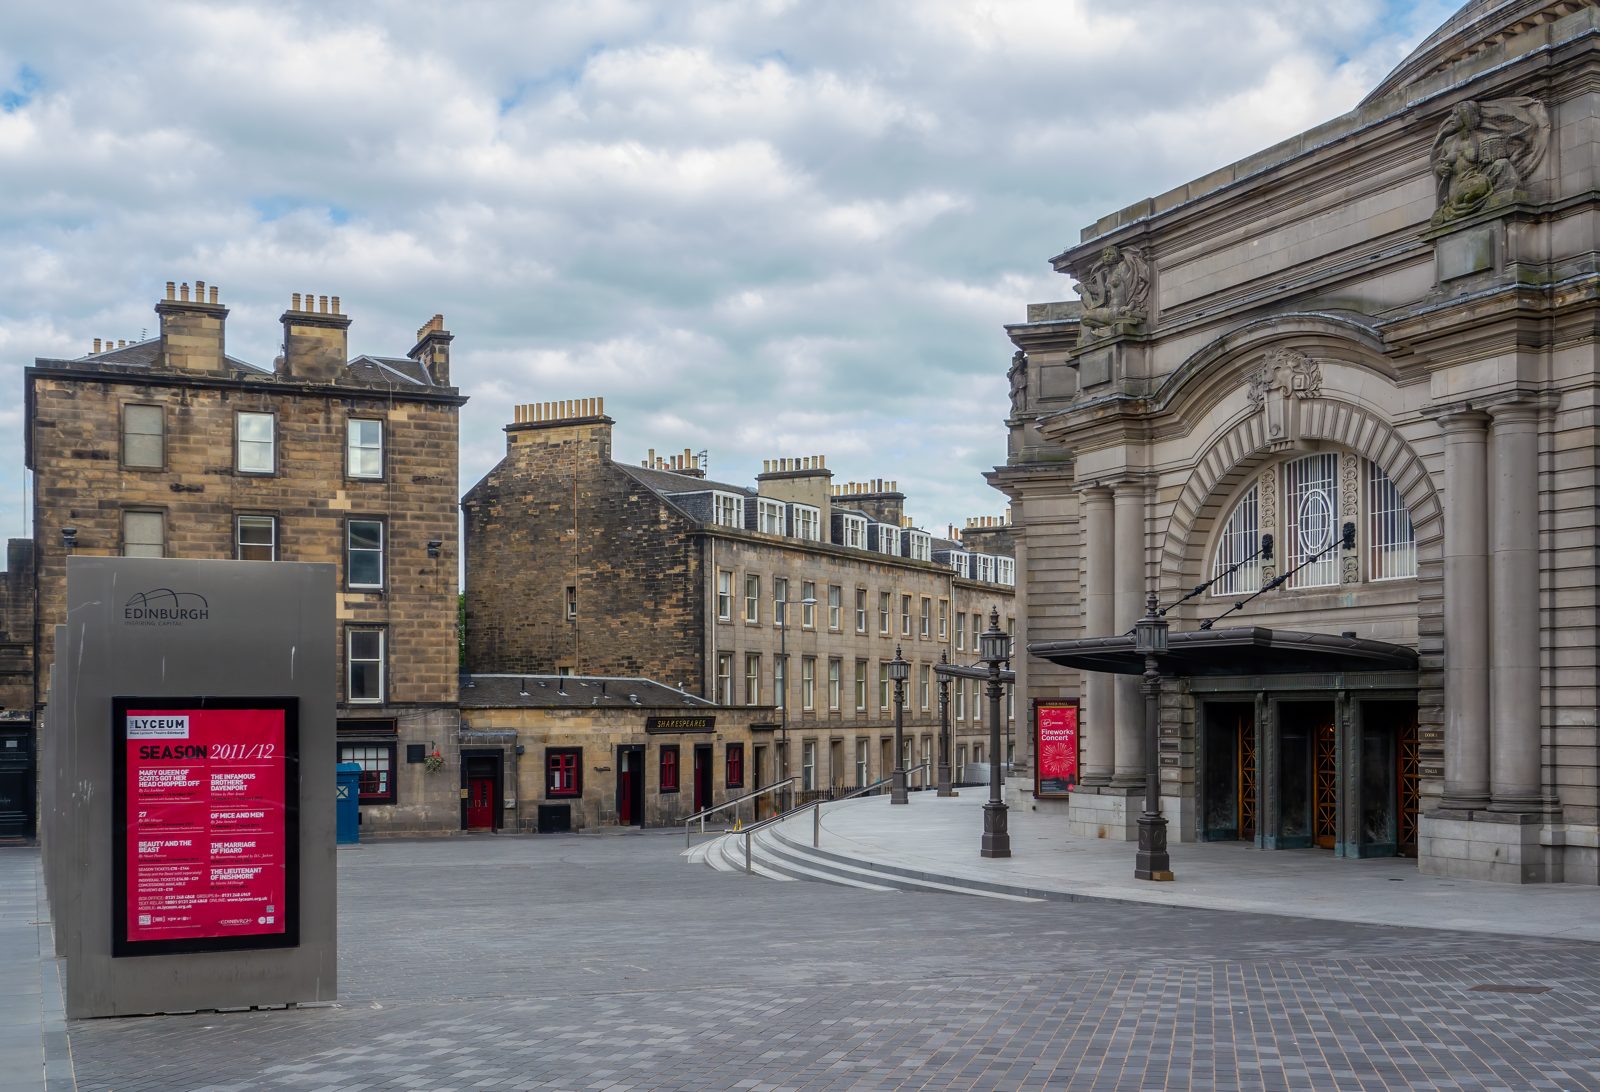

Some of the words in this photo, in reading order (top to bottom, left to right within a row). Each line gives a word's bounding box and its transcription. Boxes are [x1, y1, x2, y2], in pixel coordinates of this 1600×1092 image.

[124, 608, 208, 620] EDINBURGH
[135, 720, 184, 728] LYCEUM
[656, 720, 706, 728] SHAKESPEARES
[139, 745, 207, 760] SEASON
[210, 743, 275, 760] 2011/12
